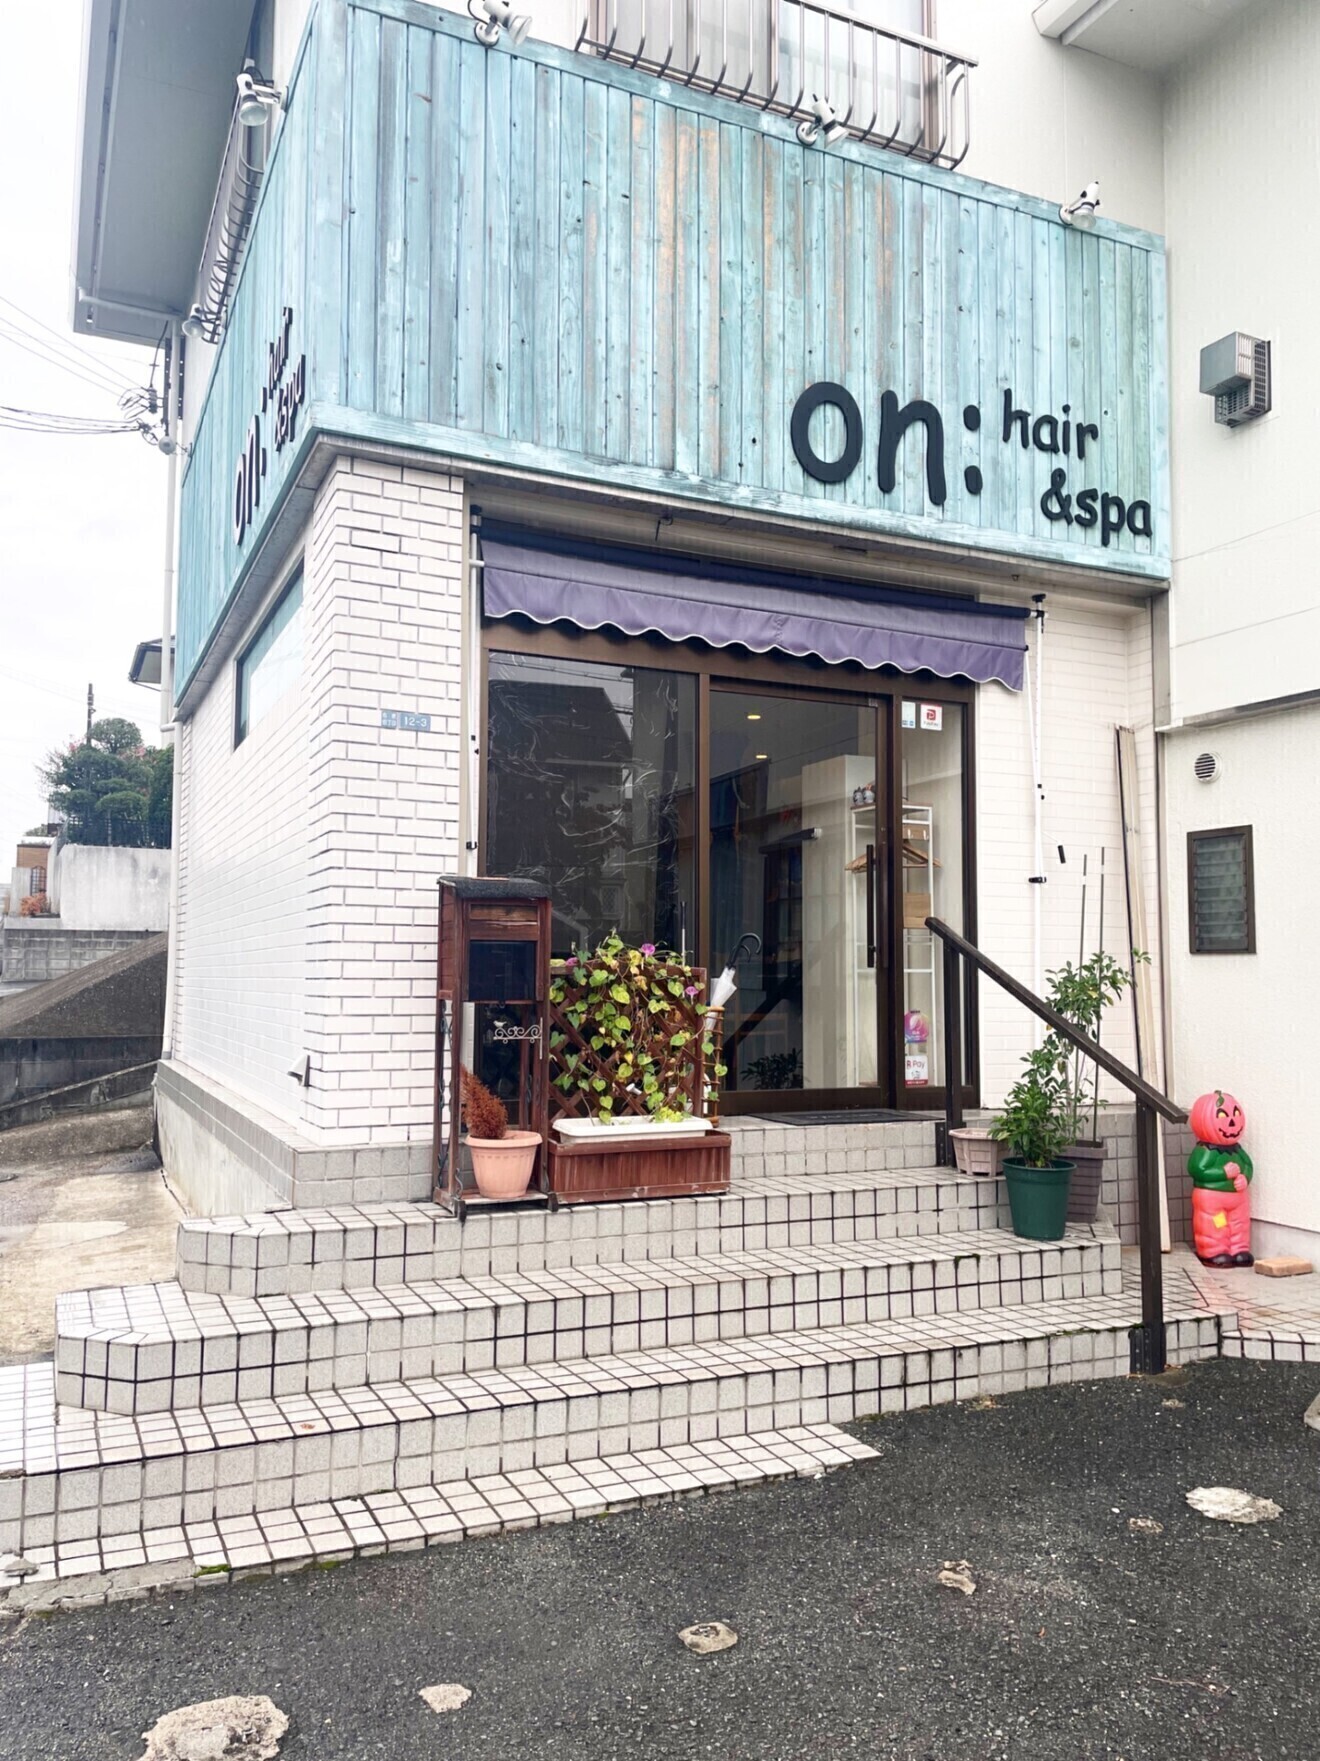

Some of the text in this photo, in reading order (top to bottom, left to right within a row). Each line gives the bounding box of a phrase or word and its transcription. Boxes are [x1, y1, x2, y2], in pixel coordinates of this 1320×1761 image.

[1003, 388, 1098, 459] hair
[1039, 467, 1152, 546] &spa
[404, 715, 427, 727] 12-3
[913, 1059, 926, 1069] Pay
